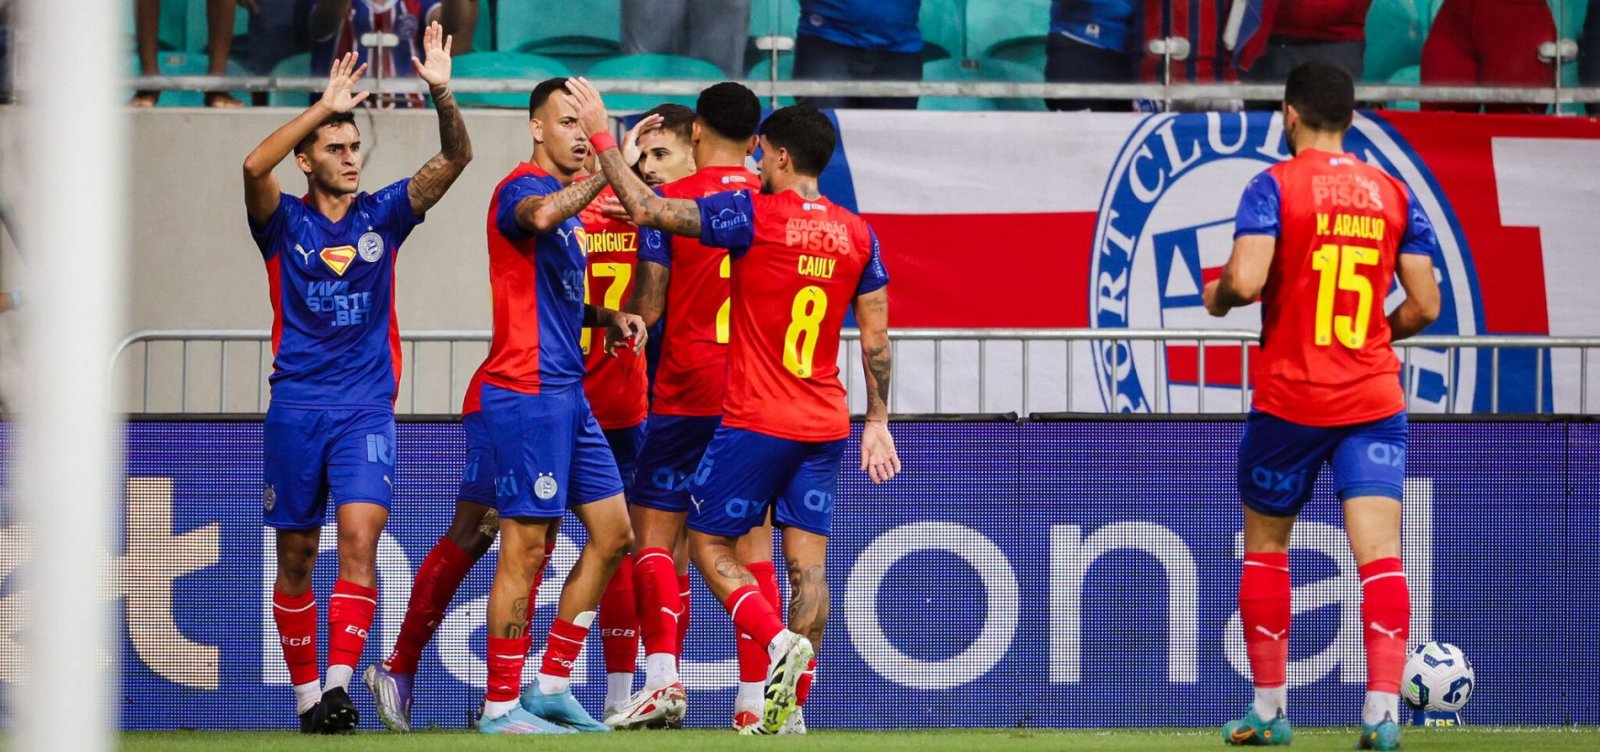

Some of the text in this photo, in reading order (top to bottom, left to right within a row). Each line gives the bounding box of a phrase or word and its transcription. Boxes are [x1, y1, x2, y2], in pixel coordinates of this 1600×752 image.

[1313, 186, 1384, 211] PISOS
[785, 217, 848, 236] ATACADÃO
[1333, 214, 1385, 241] ARAUJO
[586, 229, 637, 252] DRÍGUEZ
[785, 230, 851, 255] PISOS
[798, 254, 836, 278] CAULY
[307, 281, 349, 297] VIVA
[1312, 243, 1380, 350] 15
[306, 291, 373, 312] SORTE
[331, 310, 370, 326] .BET
[783, 285, 827, 378] 8
[282, 635, 311, 647] ECB
[344, 624, 368, 640] EC
[602, 628, 636, 637] ECB
